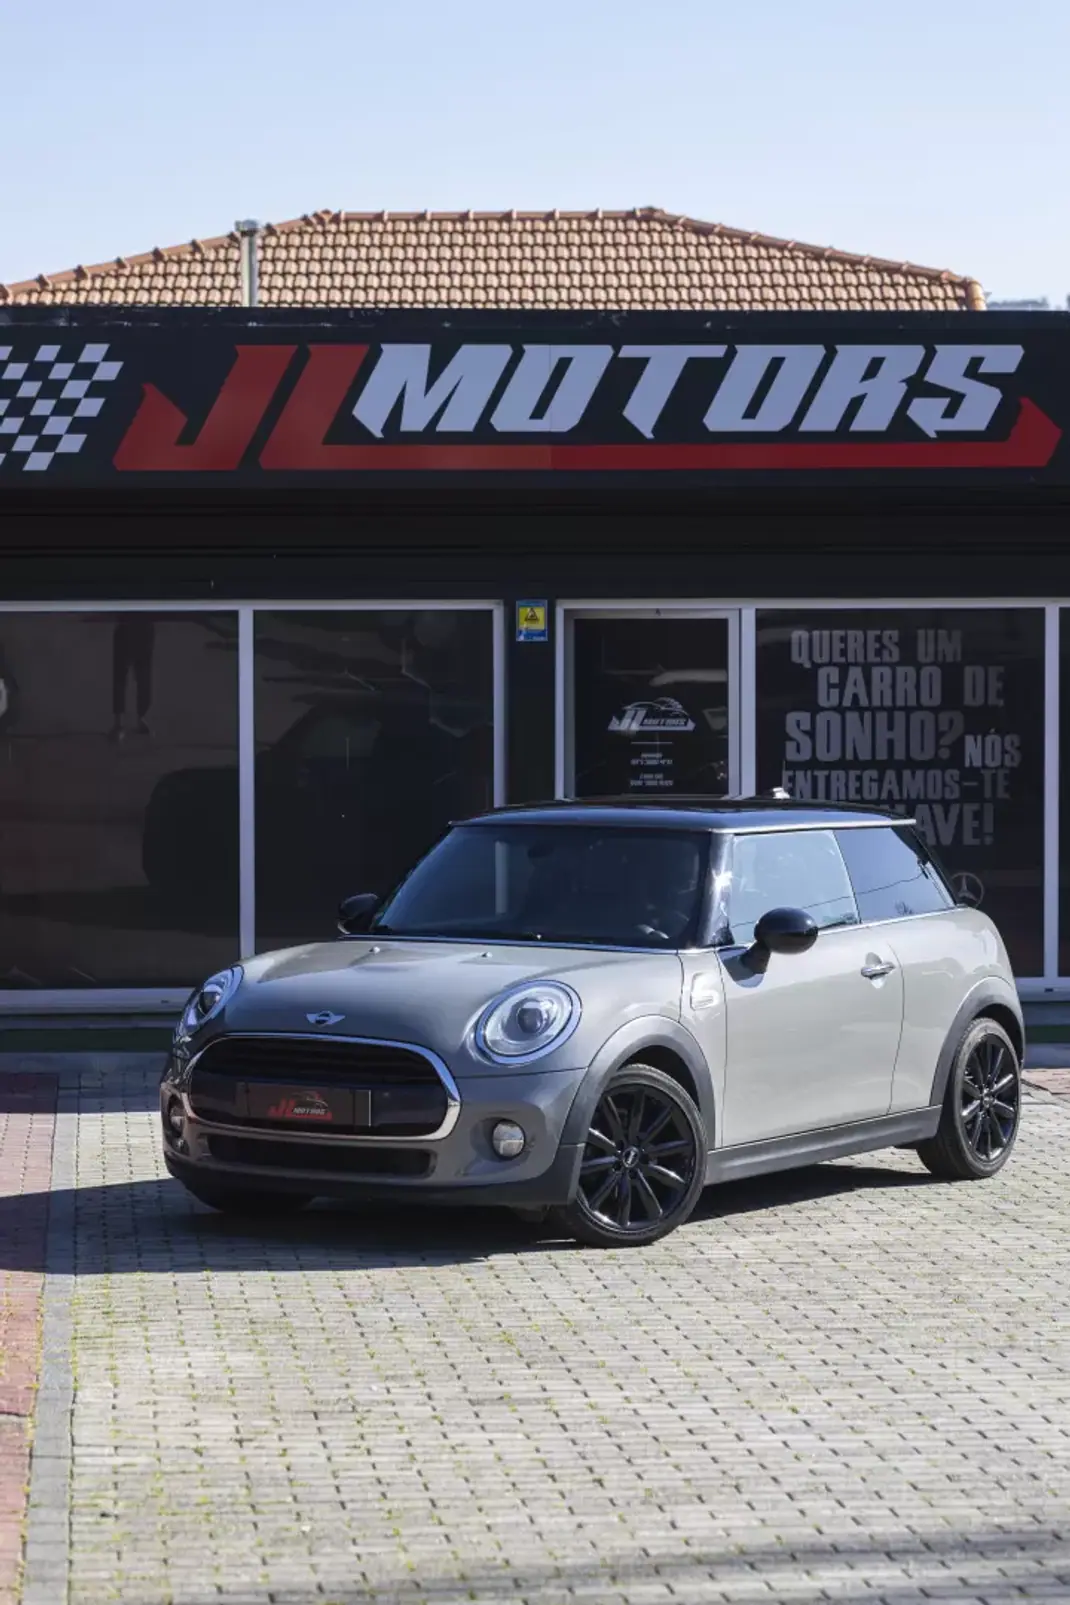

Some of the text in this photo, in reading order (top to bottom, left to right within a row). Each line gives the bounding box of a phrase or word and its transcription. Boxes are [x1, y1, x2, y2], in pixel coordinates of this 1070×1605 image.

[790, 628, 962, 668] QUERES UM
[817, 665, 1005, 708] CARRO DE
[785, 710, 1022, 768] SONHO? NÓS
[783, 768, 1010, 801] ENTREGAMOS-TE
